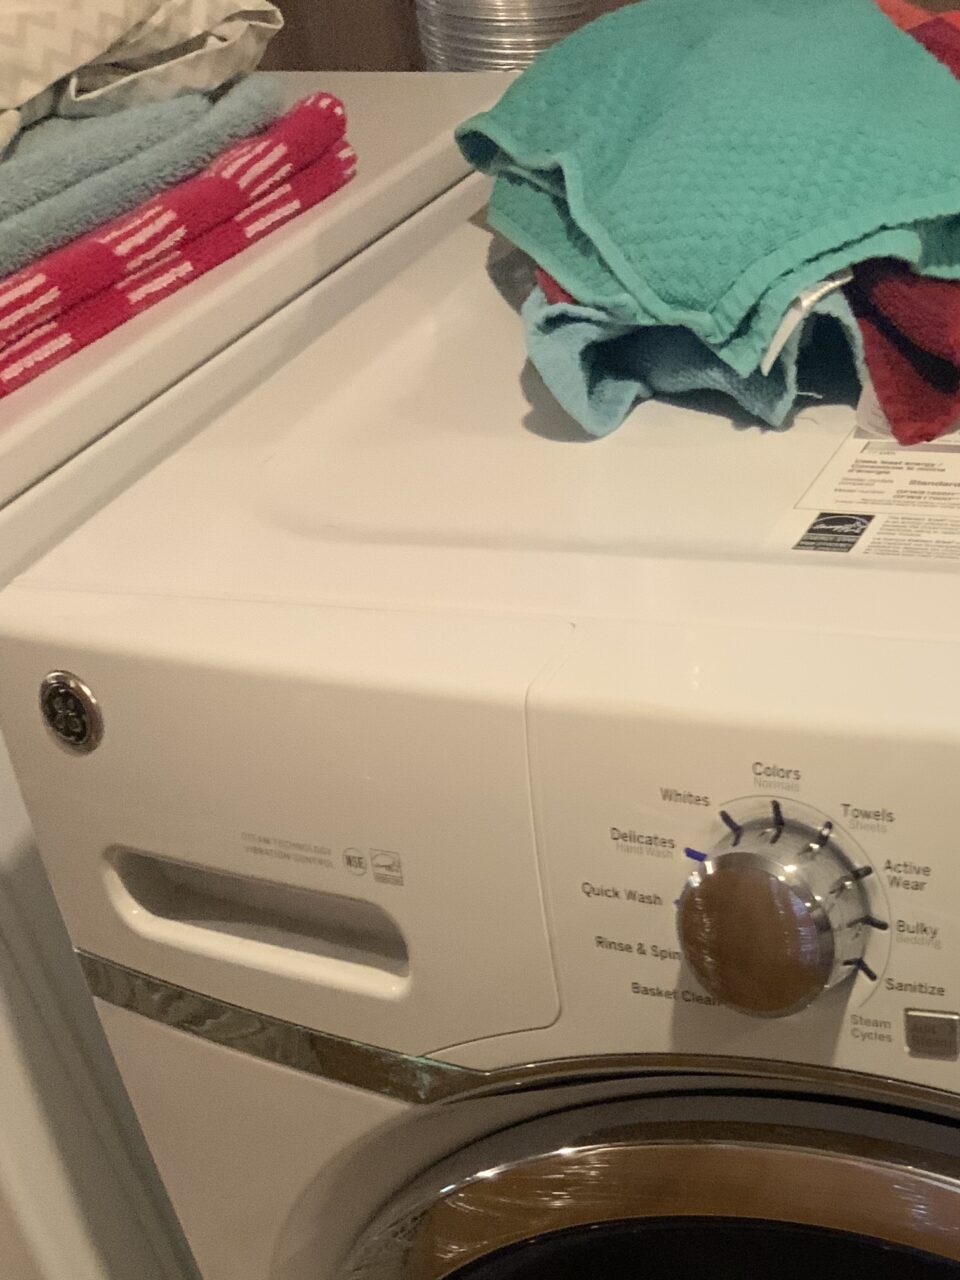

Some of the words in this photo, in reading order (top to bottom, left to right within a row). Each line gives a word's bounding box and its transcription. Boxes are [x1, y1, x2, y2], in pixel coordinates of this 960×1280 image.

[752, 762, 801, 781] Colors
[659, 787, 711, 807] Whites
[840, 803, 896, 823] Towels
[609, 826, 676, 849] Delicates
[884, 859, 932, 877] Active
[581, 881, 620, 900] Quick
[624, 887, 663, 906] Wash
[888, 875, 928, 892] Wear
[896, 919, 938, 939] Bulky
[595, 935, 634, 953] Rinse
[636, 942, 647, 956] &
[651, 944, 682, 961] Spin
[631, 981, 678, 1001] Basket
[681, 990, 721, 1007] Clean
[885, 977, 945, 997] Sanitize
[850, 1013, 892, 1029] Steam
[850, 1028, 893, 1043] Cycles
